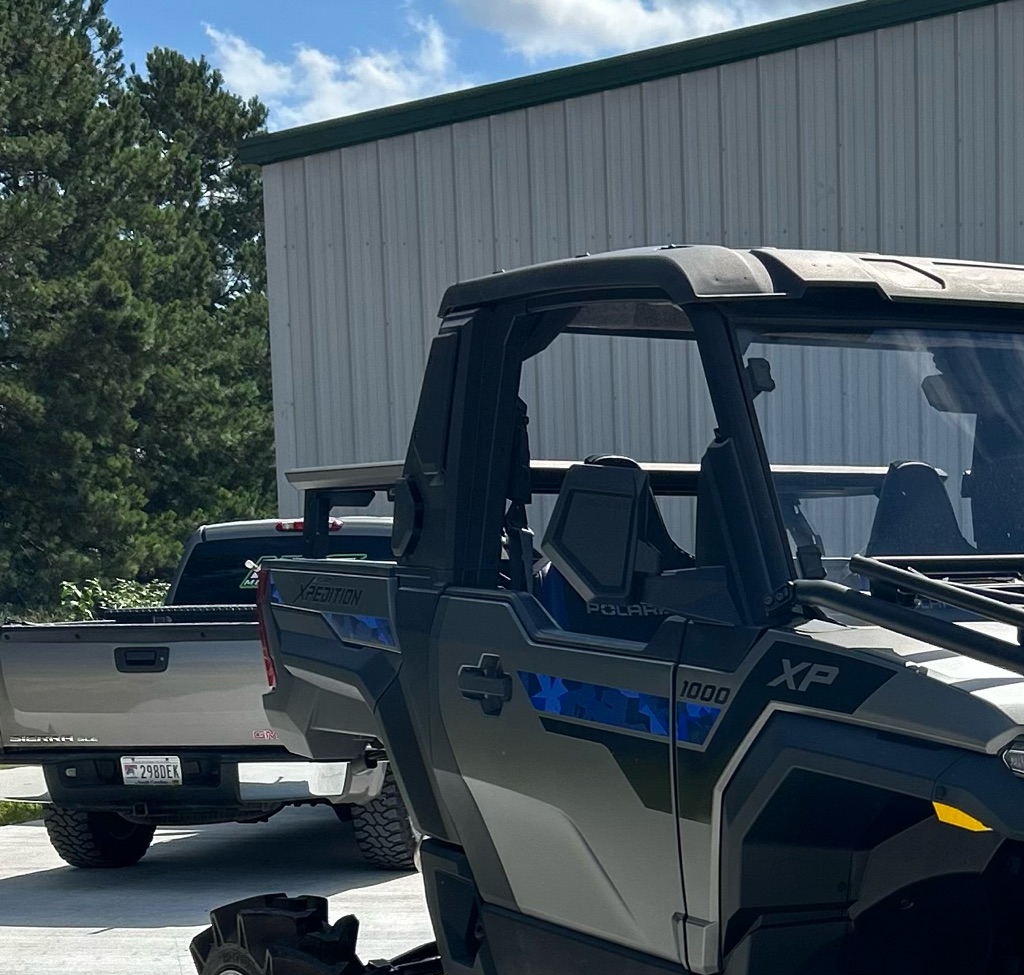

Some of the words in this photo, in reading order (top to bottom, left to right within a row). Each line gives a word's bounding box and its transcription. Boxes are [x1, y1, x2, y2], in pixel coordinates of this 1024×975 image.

[292, 576, 364, 607] XPEDITION
[766, 658, 840, 692] XP
[679, 680, 731, 705] 1000
[252, 729, 279, 741] GM
[139, 764, 180, 779] 298DEK
